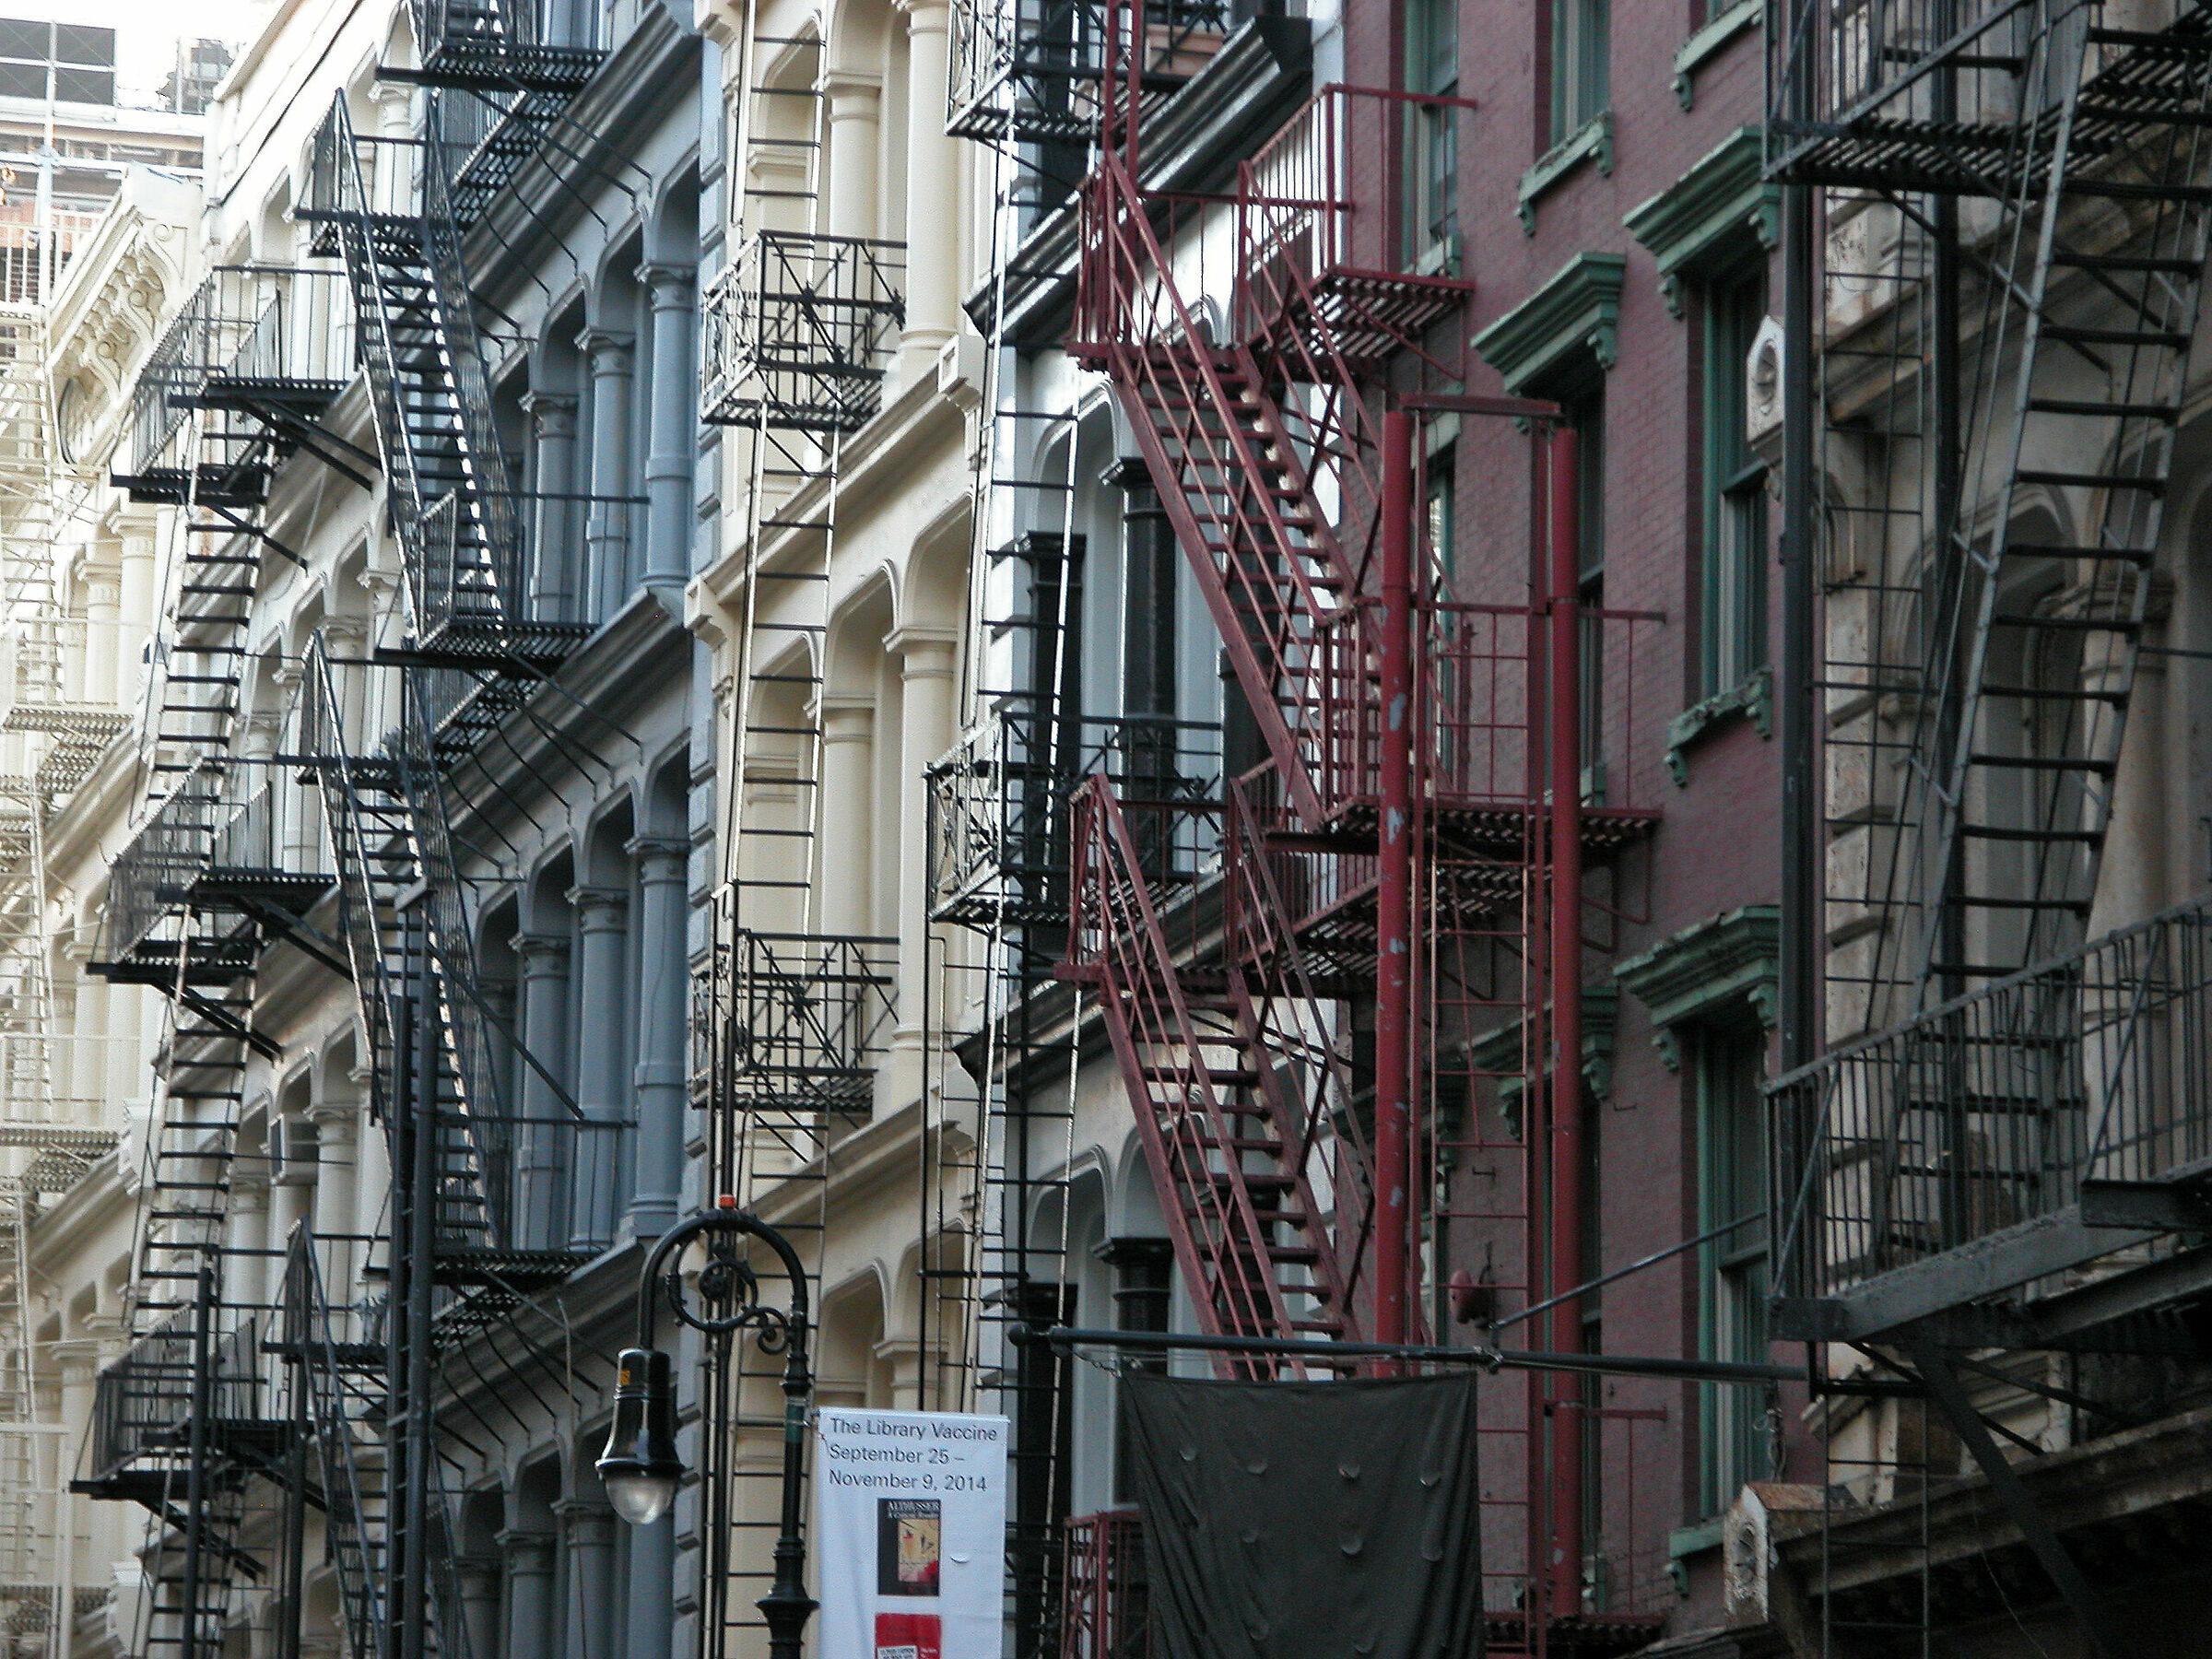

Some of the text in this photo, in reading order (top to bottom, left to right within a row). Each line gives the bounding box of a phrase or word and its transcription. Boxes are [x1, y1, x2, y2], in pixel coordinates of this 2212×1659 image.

[830, 1418, 997, 1441] The Library Vaccine
[830, 1443, 922, 1463] September
[830, 1469, 988, 1491] November 9, 2014
